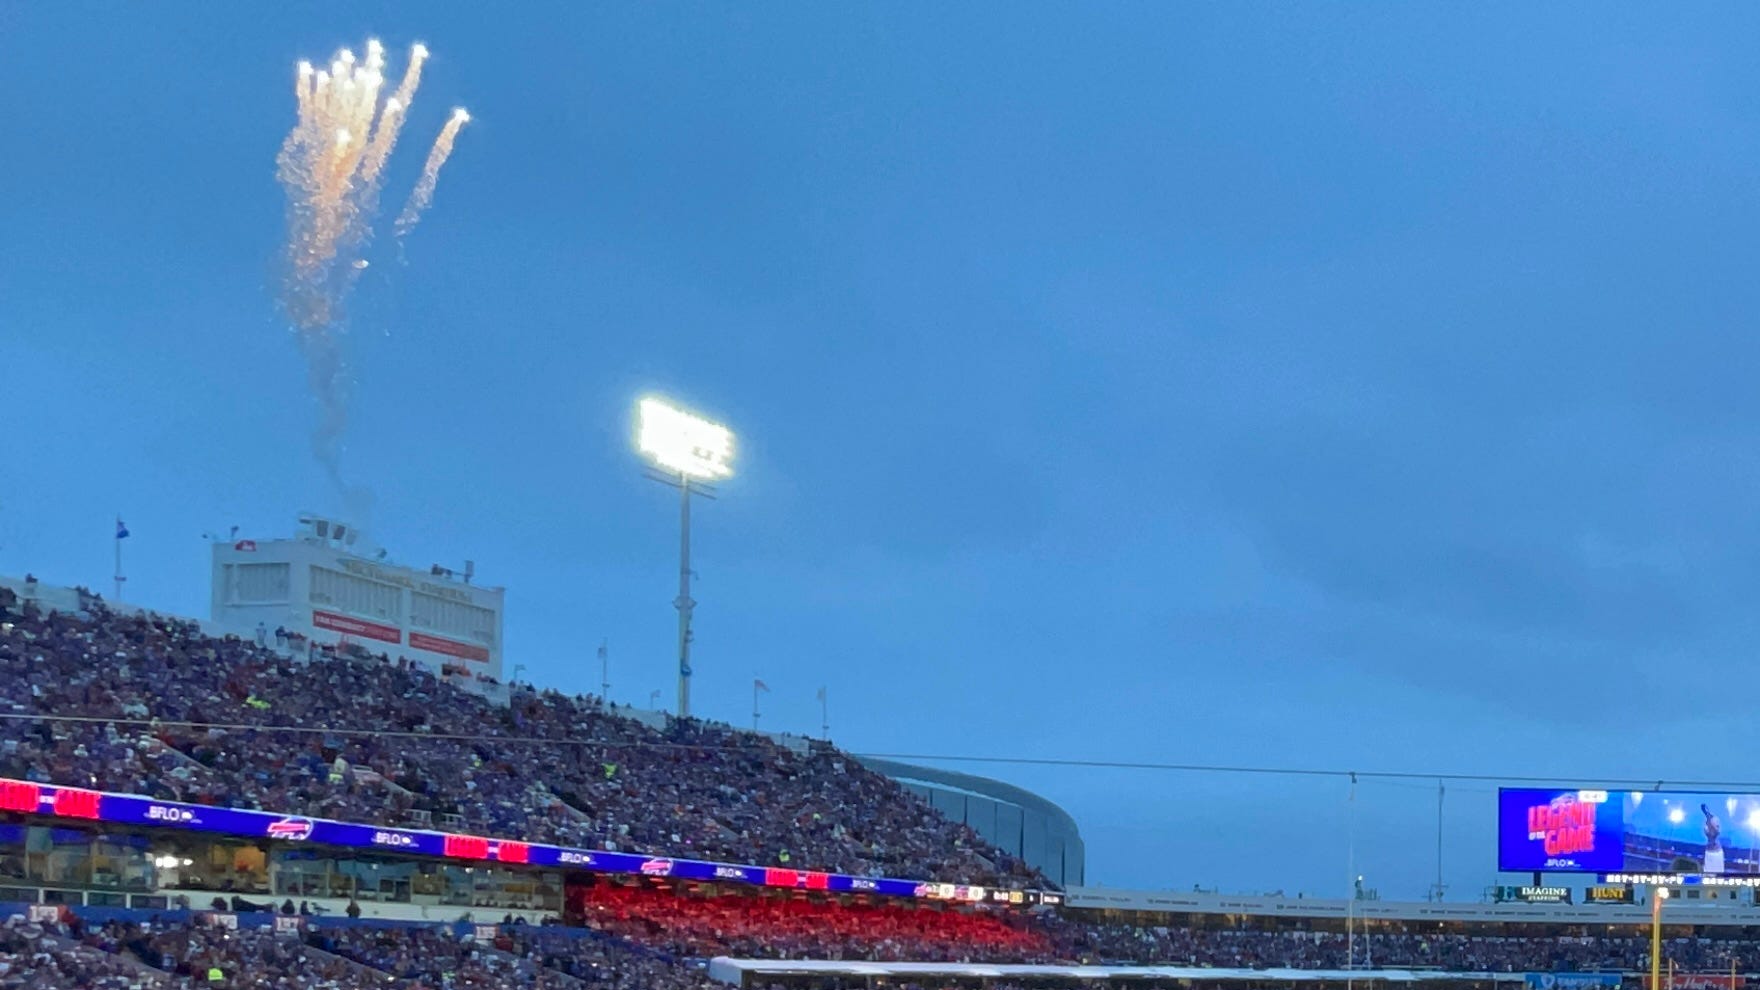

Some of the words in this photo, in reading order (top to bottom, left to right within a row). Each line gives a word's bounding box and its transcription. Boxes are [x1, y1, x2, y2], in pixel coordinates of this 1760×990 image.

[149, 805, 179, 821] BFLO
[376, 832, 401, 845] BFLO
[1521, 887, 1566, 896] IMAGINE
[1592, 888, 1625, 899] HUNT
